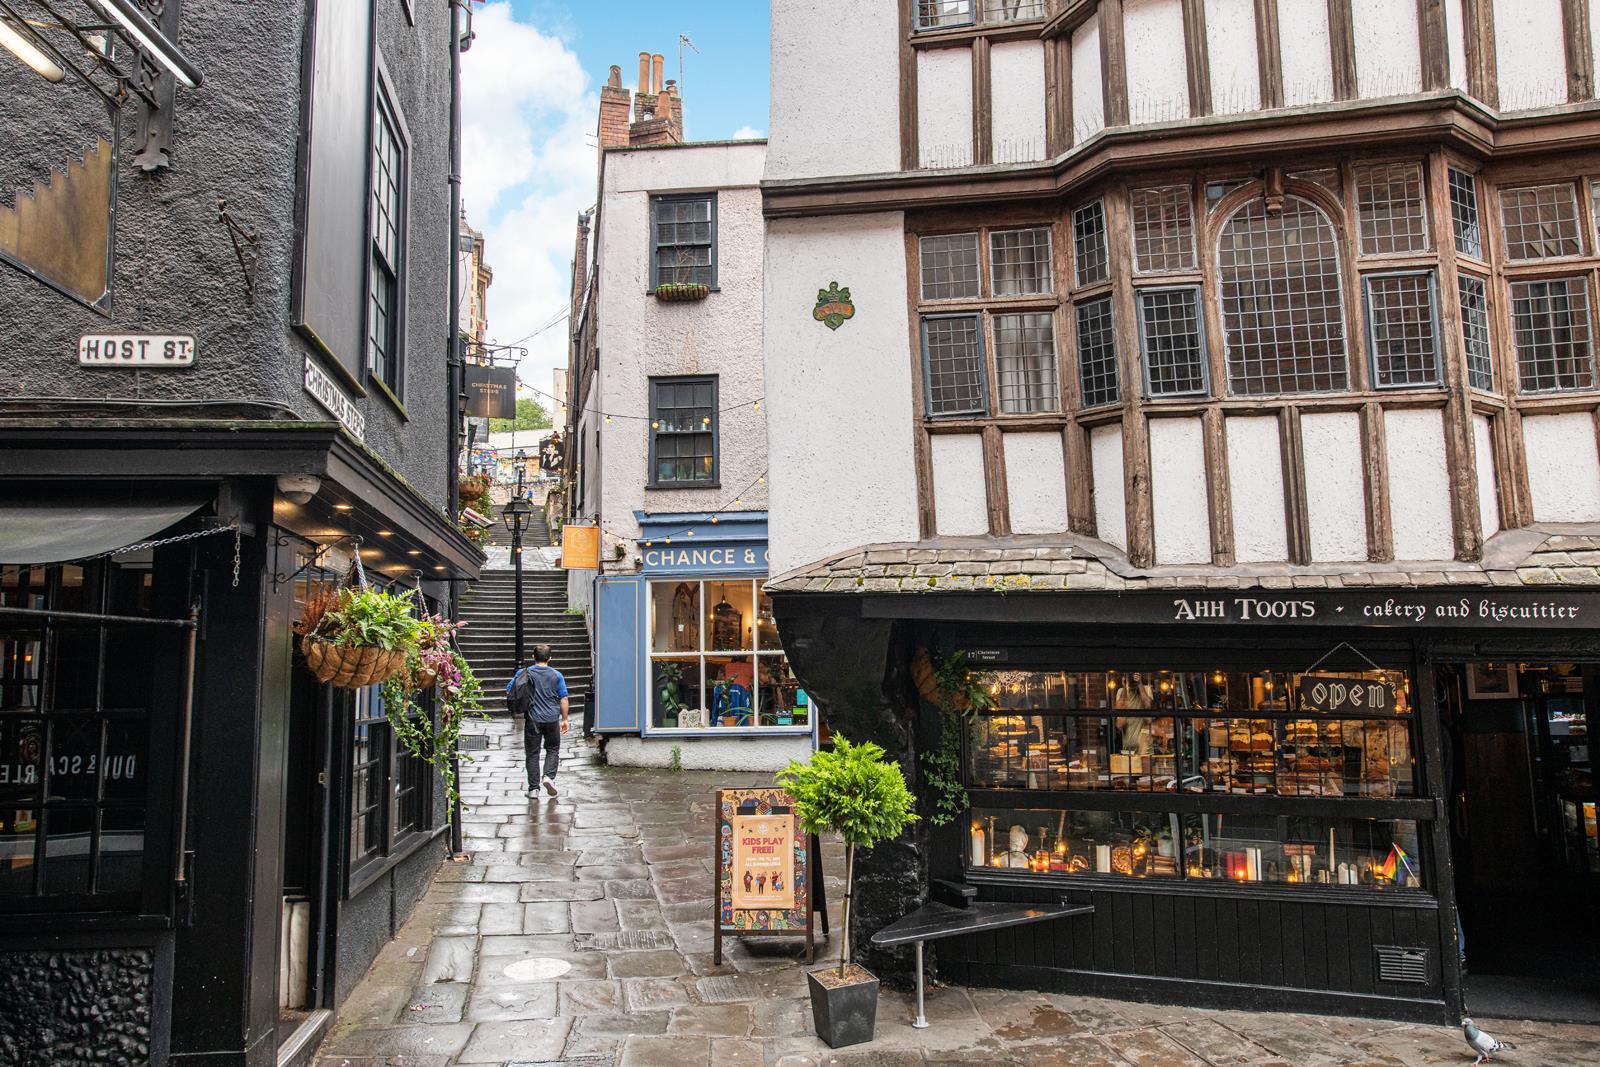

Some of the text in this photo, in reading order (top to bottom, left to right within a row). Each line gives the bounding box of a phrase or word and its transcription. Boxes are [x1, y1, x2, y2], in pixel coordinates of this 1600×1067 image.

[86, 339, 150, 360] HOST
[307, 364, 364, 438] CHRISTMAS STEPS
[645, 549, 736, 566] CHANCE
[743, 548, 756, 564] &
[1363, 598, 1427, 622] cakery
[1435, 598, 1470, 618] and
[1479, 599, 1580, 622] biscuitier
[967, 651, 975, 659] 17
[1311, 682, 1385, 710] open
[742, 837, 785, 846] KIDS PLAY
[751, 846, 775, 854] FREE!
